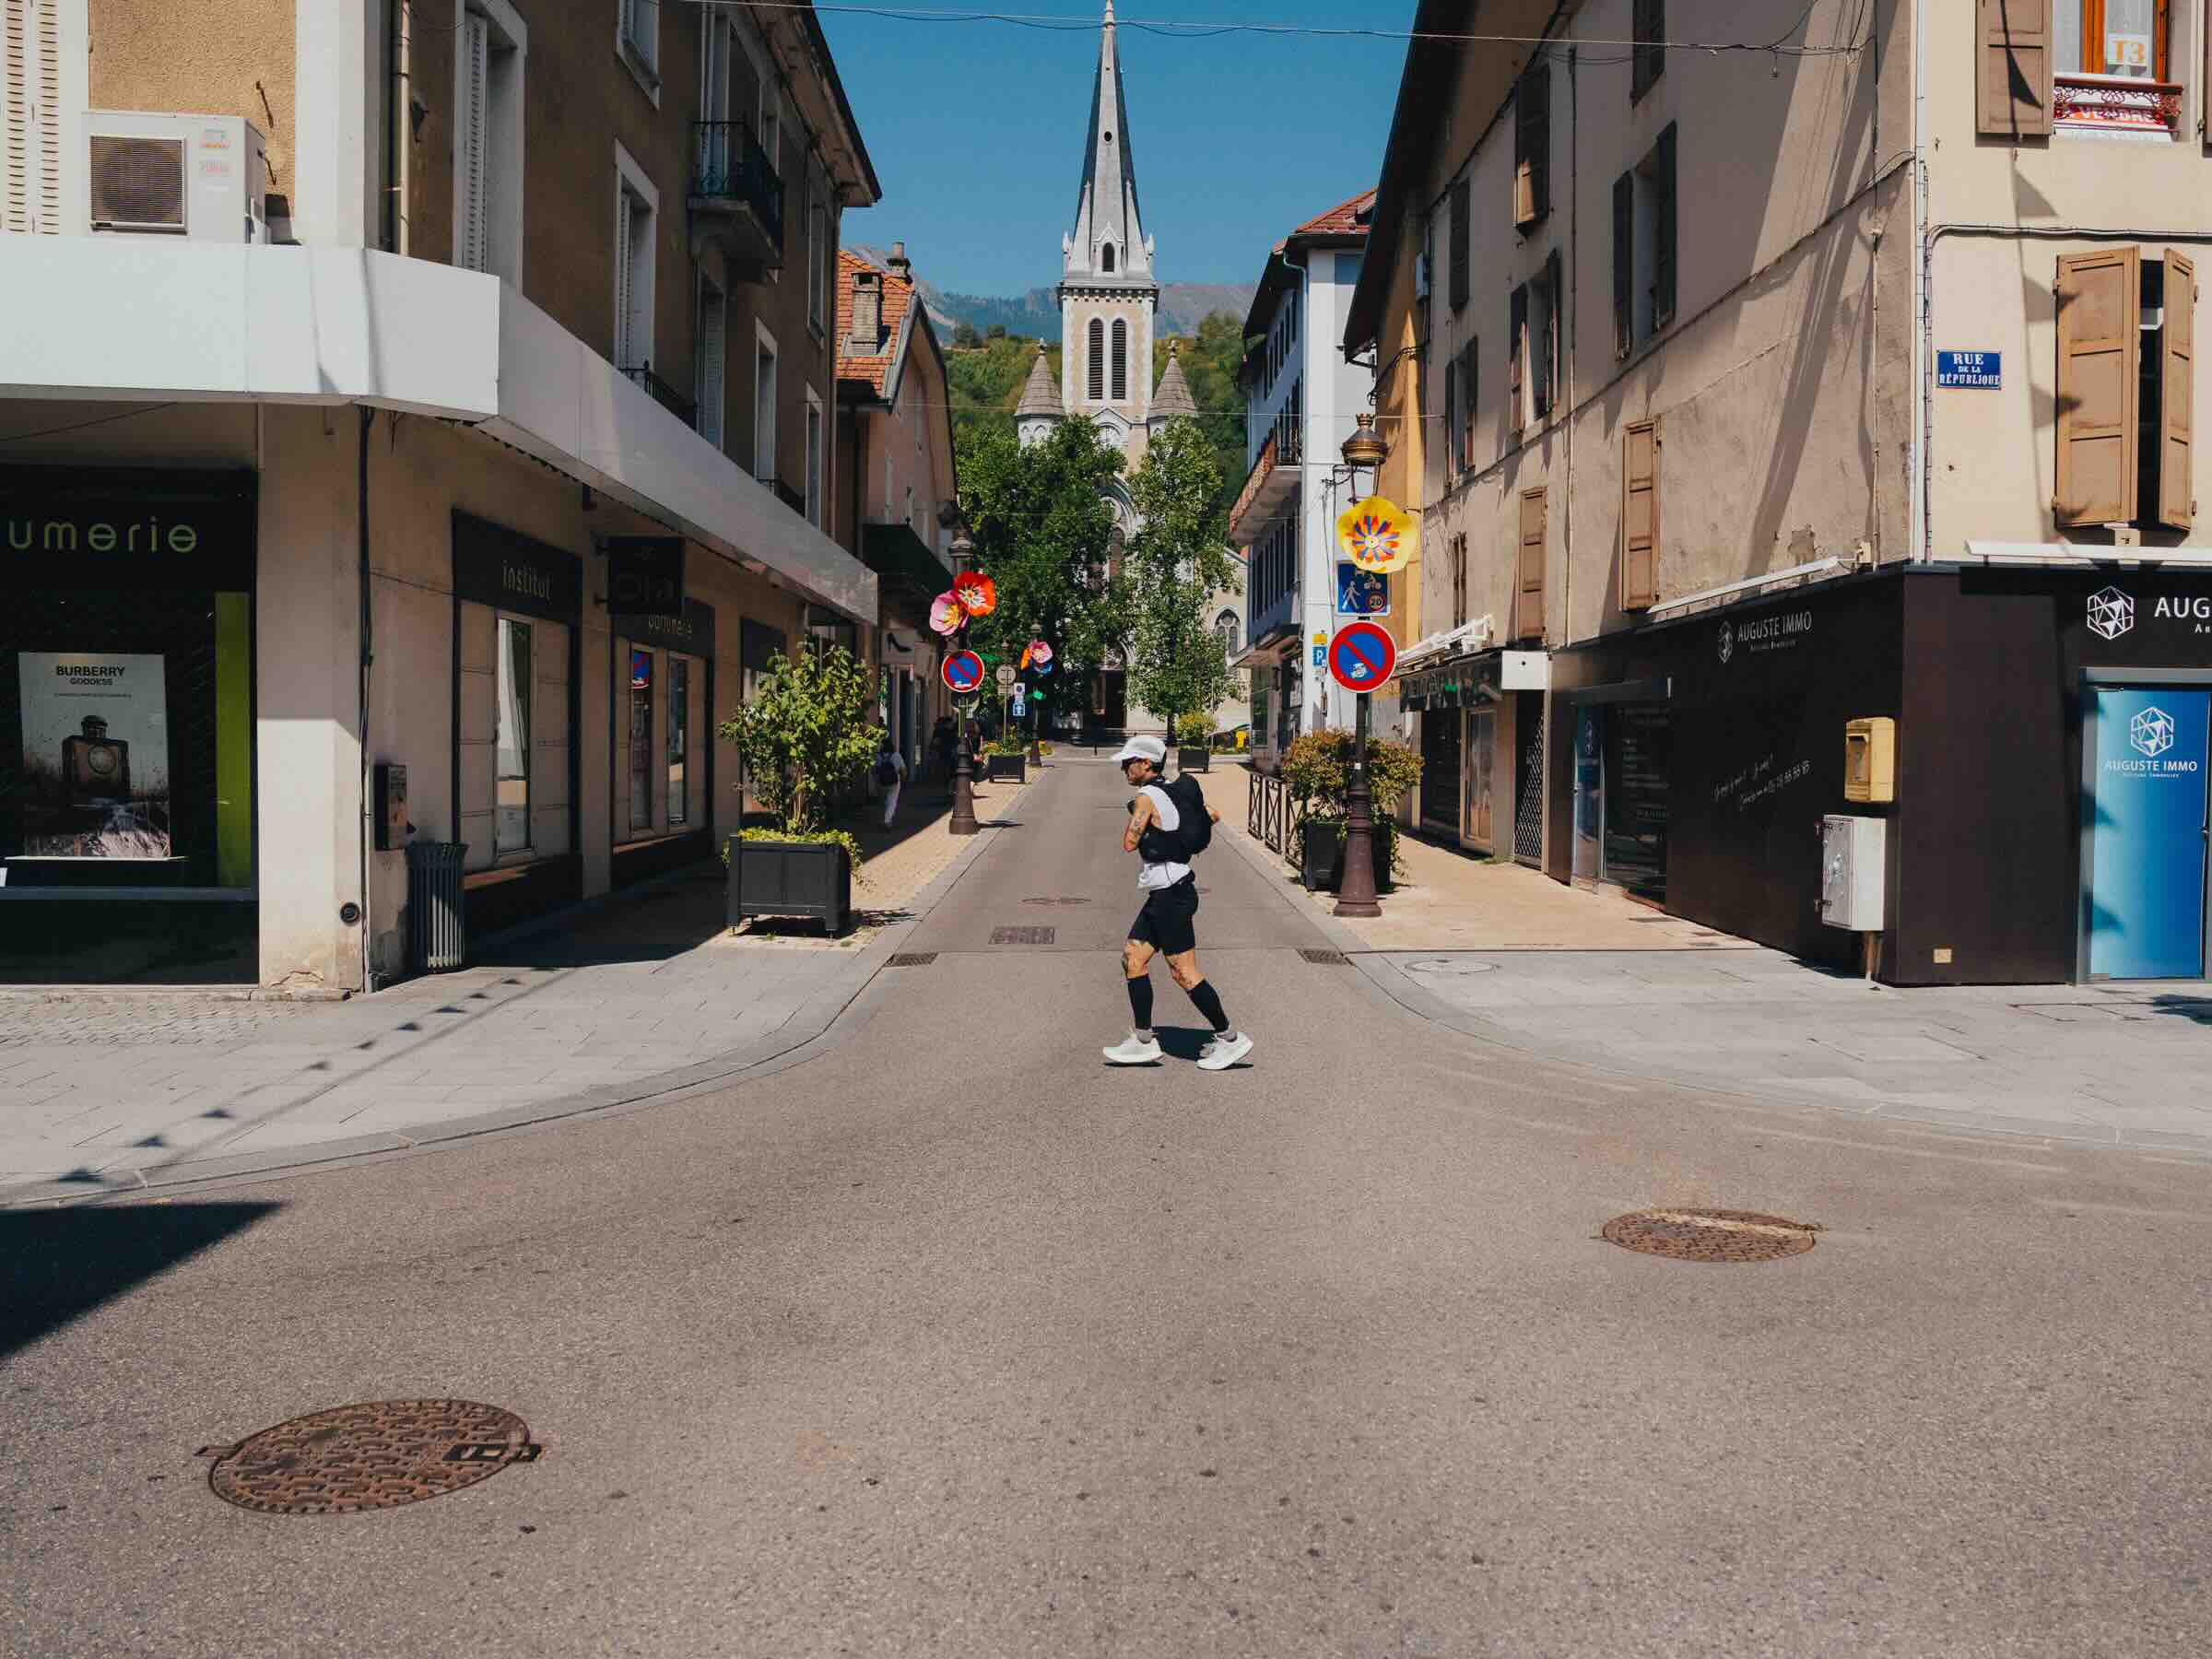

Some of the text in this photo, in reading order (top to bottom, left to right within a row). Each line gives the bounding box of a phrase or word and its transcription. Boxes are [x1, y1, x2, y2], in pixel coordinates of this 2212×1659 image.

[2112, 39, 2145, 65] T3
[1953, 353, 1984, 365] RUE
[1958, 365, 1982, 373] DE LA
[1938, 371, 2000, 384] RÉPUBLIQUE
[8, 515, 197, 553] umerie
[2154, 596, 2212, 618] AUG
[1737, 611, 1813, 642] AUGUSTE IMMO
[56, 665, 126, 677] BURBERRY
[2103, 759, 2198, 772] AUGUSTE IMMO
